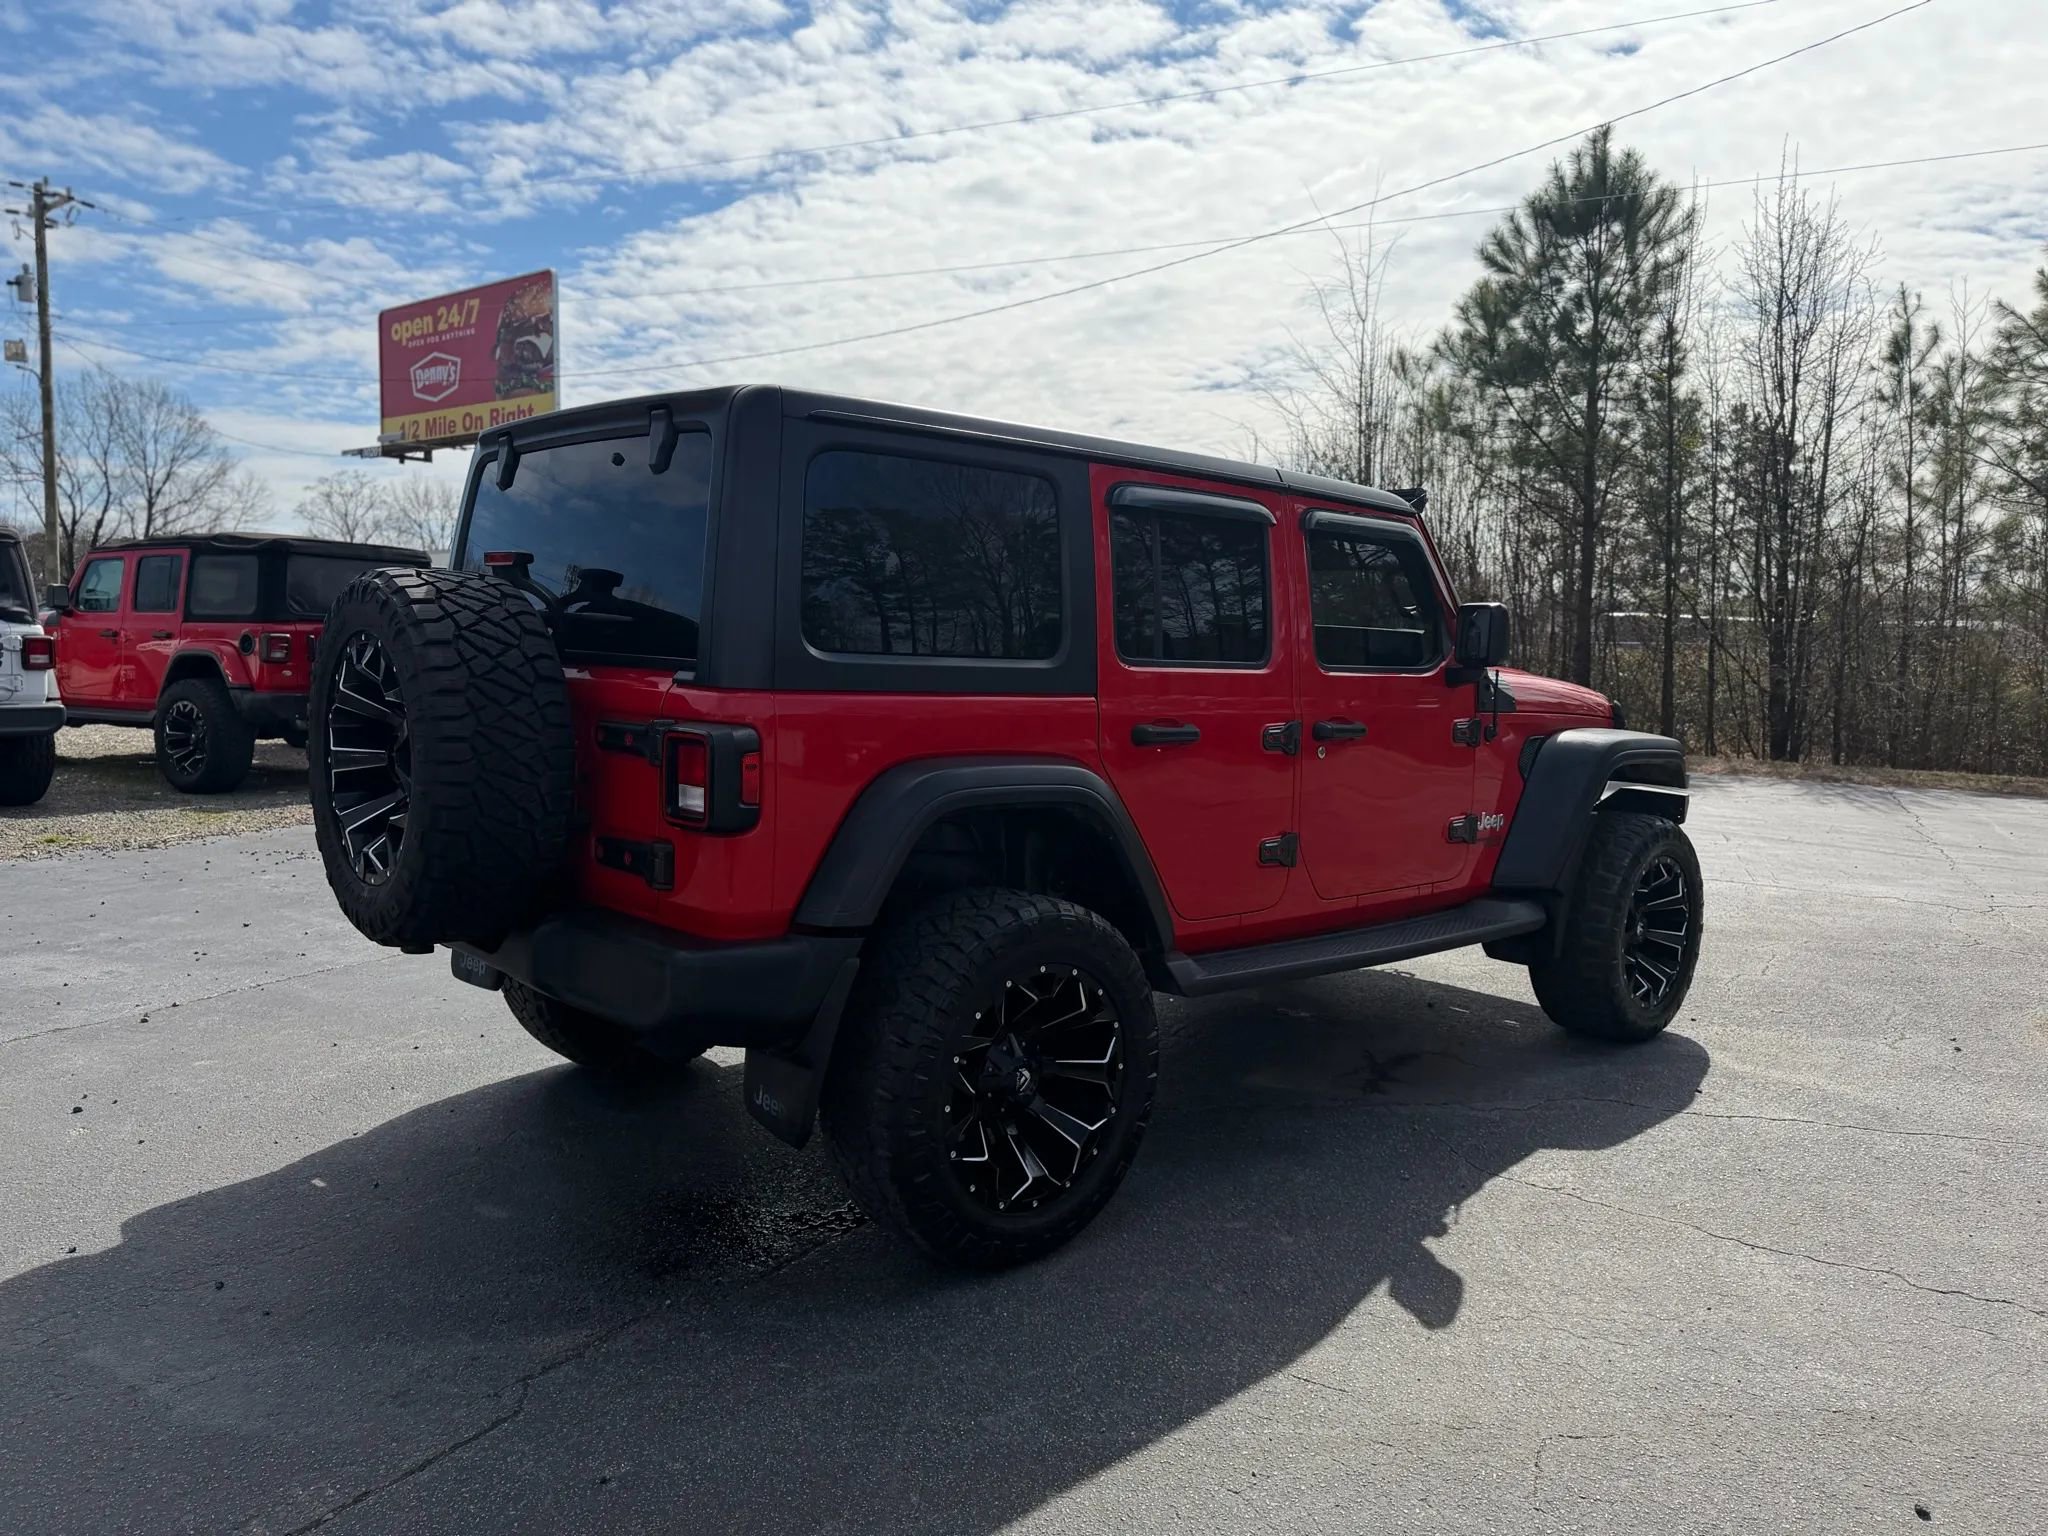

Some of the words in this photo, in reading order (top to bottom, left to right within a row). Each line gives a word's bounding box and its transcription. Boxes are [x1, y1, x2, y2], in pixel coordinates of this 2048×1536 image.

[391, 314, 433, 347] open
[437, 298, 480, 331] 24/7
[415, 361, 456, 390] Denny's
[399, 420, 420, 440] 1/2
[424, 415, 457, 438] Mile
[462, 411, 484, 432] On
[1477, 811, 1504, 832] Jeep
[460, 953, 487, 977] Jeep
